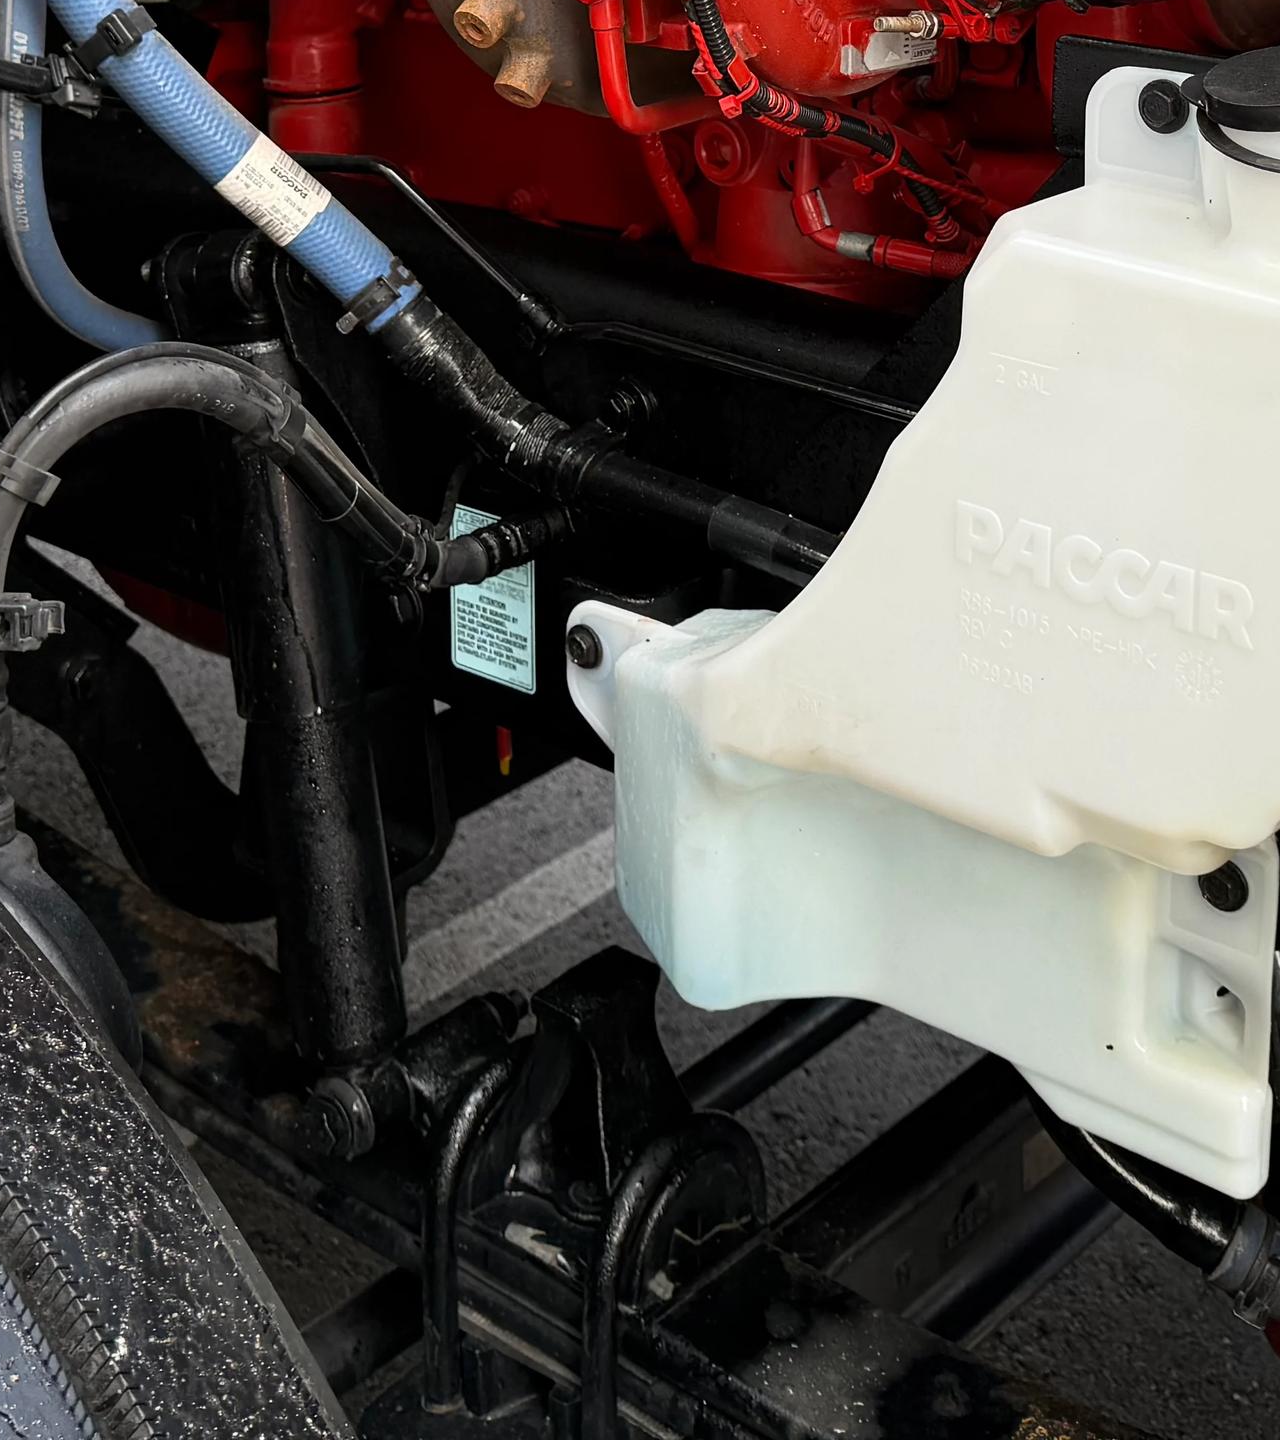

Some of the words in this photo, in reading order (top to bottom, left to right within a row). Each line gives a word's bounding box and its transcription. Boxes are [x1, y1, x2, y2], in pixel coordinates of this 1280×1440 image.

[270, 165, 308, 200] PACCAR
[1016, 369, 1053, 397] GAL
[953, 497, 1256, 652] PACCAR
